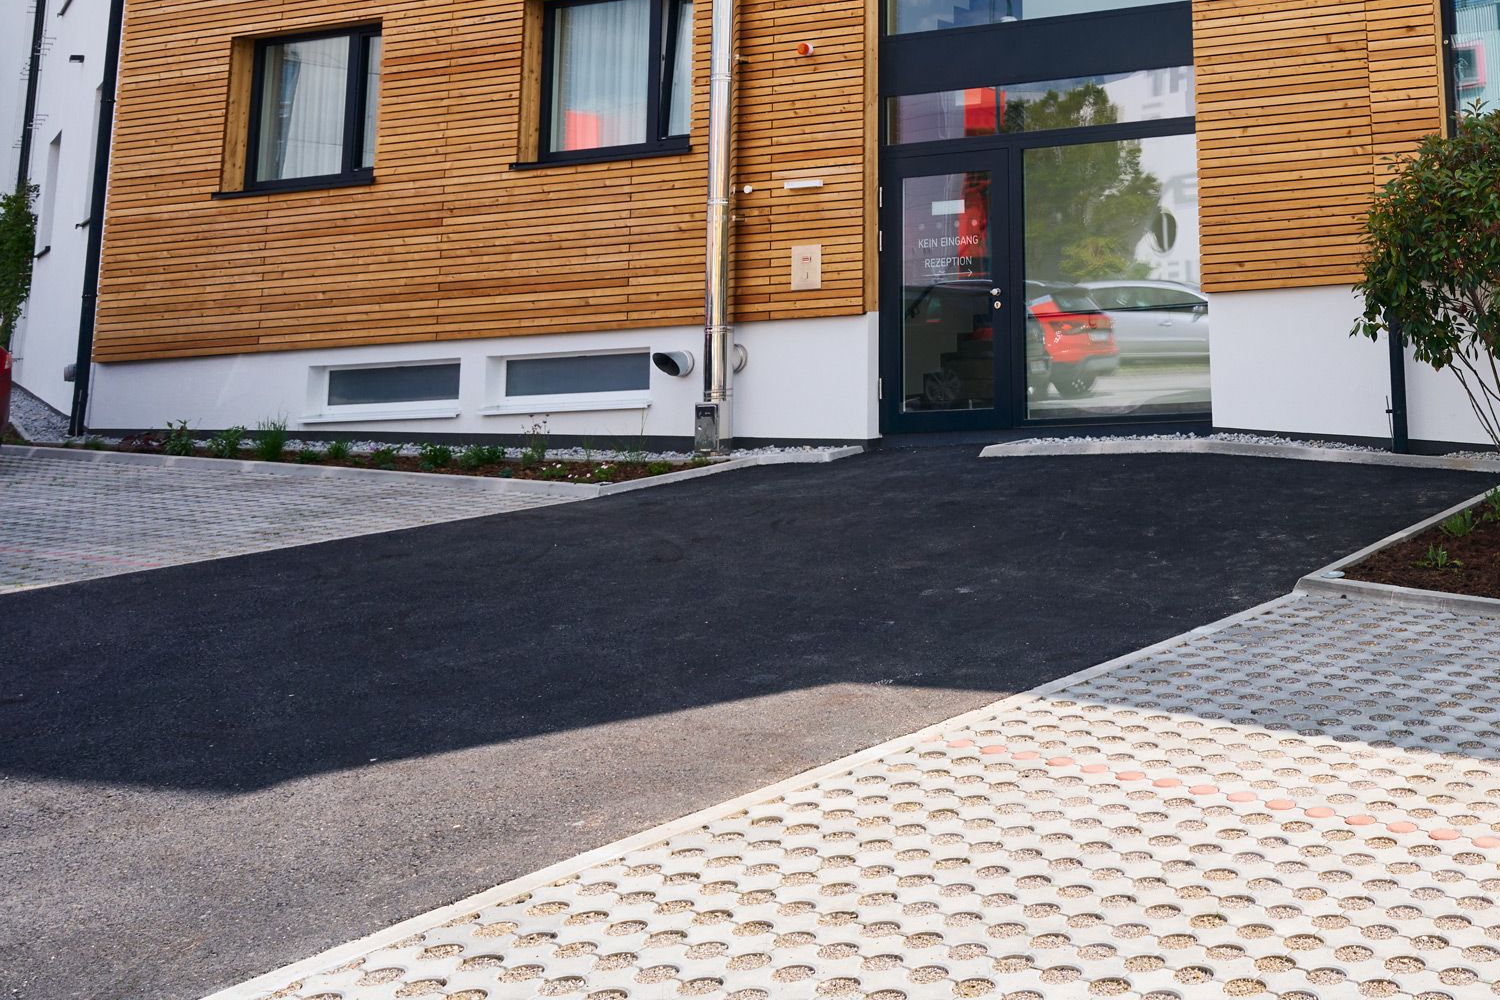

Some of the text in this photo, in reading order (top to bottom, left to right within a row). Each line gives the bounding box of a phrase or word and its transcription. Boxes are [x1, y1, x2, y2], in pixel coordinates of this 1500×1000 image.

[918, 235, 979, 249] KEIN EINGANG
[924, 256, 972, 268] REZEPTION
